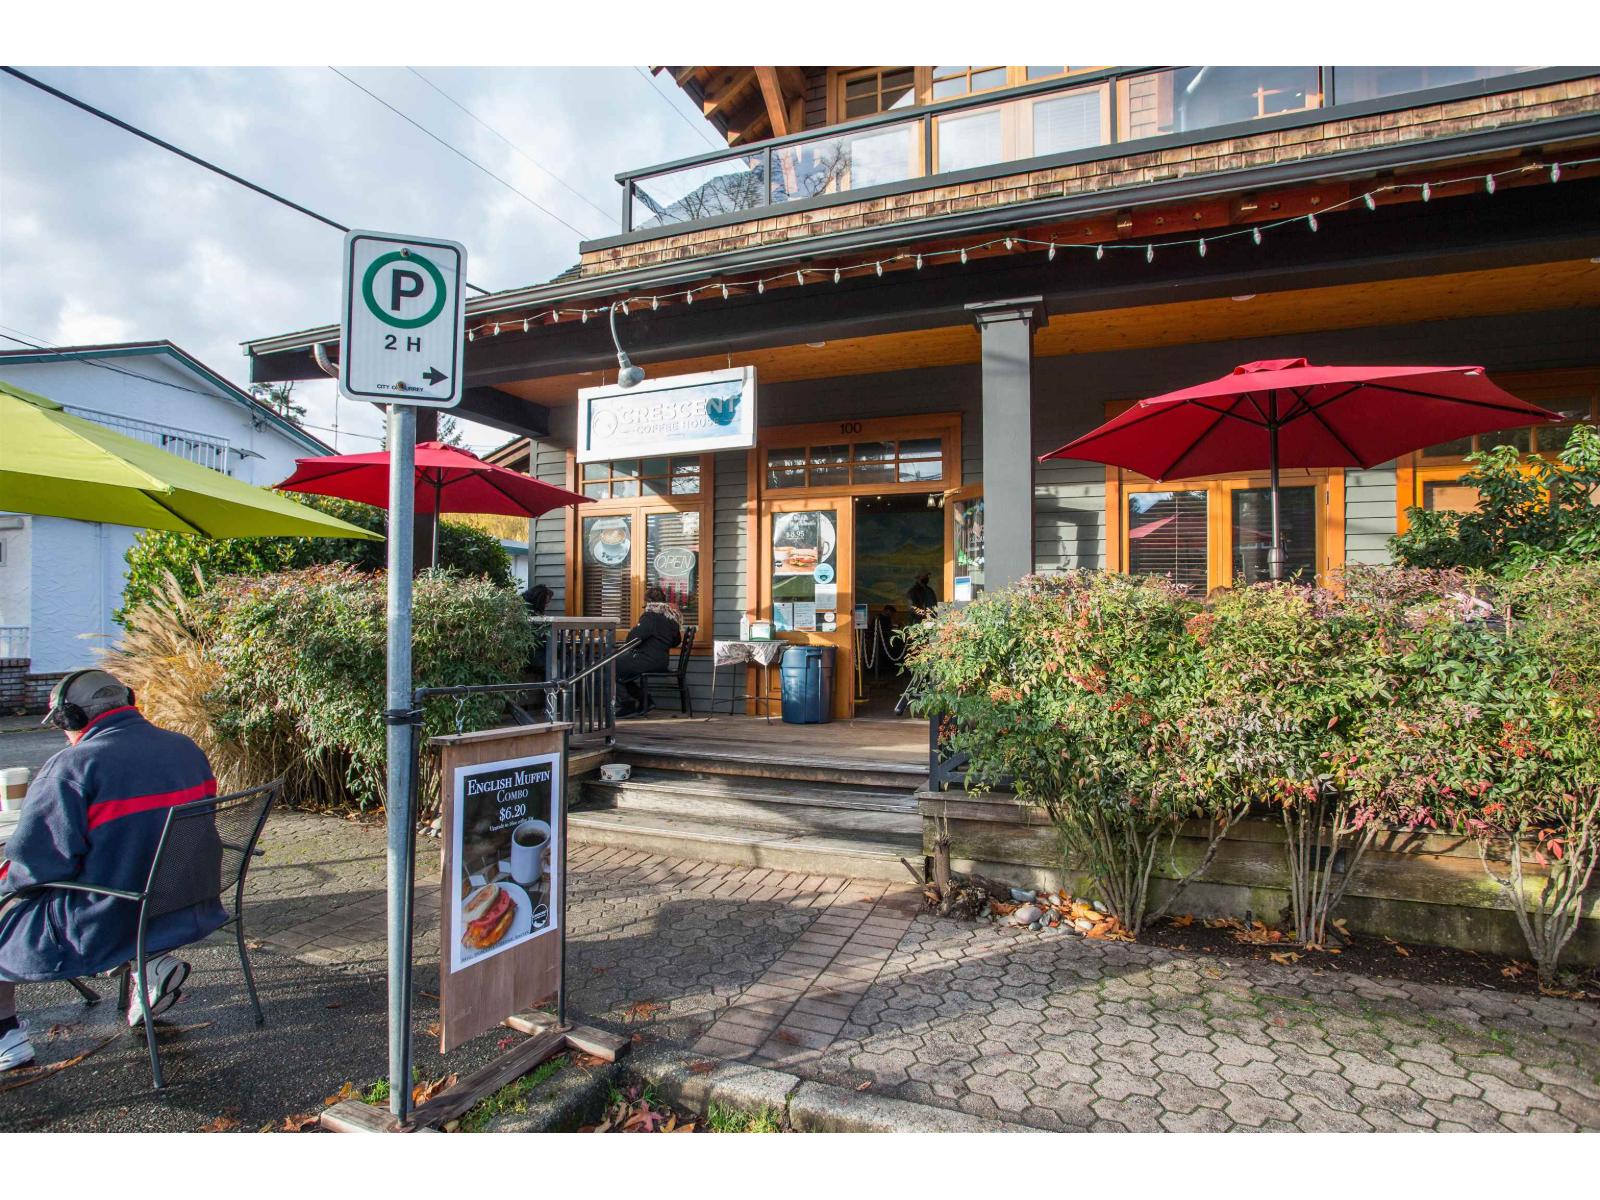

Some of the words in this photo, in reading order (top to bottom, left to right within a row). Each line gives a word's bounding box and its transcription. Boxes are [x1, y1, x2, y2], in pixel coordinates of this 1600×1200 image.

[391, 268, 424, 311] P
[384, 334, 397, 350] 2
[407, 336, 421, 352] H
[402, 384, 424, 392] URREY
[622, 394, 737, 425] CRESCENT
[840, 422, 861, 434] 100
[656, 554, 692, 569] OPEN
[467, 777, 513, 796] ENGLISH
[514, 770, 551, 787] MUFFIN
[496, 788, 528, 803] COMBO
[499, 803, 526, 822] $6.20
